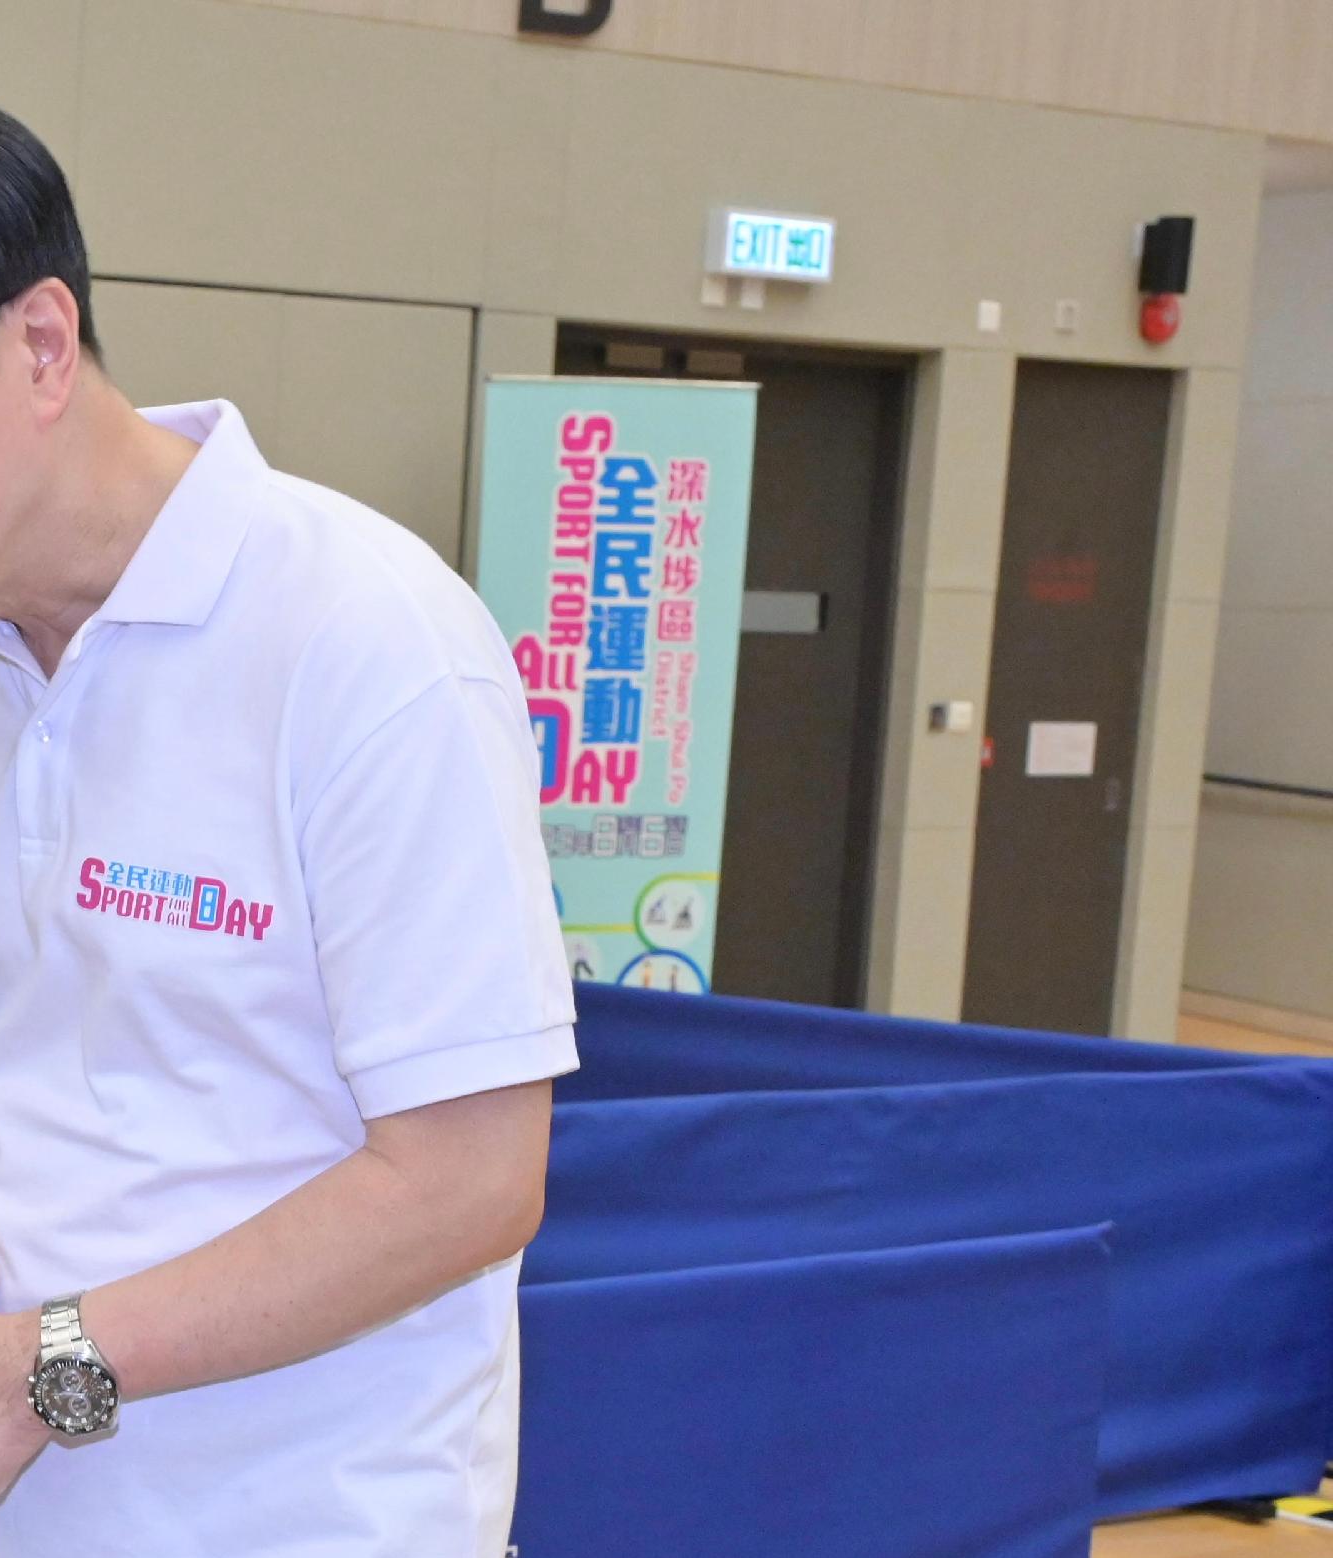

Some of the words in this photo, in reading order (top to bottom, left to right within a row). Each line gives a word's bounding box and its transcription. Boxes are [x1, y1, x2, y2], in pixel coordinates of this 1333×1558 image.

[554, 416, 612, 563] SPORT
[581, 457, 658, 744] 全民運動
[655, 460, 709, 642] 深水埗區
[549, 573, 585, 647] FOR
[76, 857, 170, 923] SPORT
[189, 876, 274, 941] DAY
[107, 861, 192, 898] 全民運動
